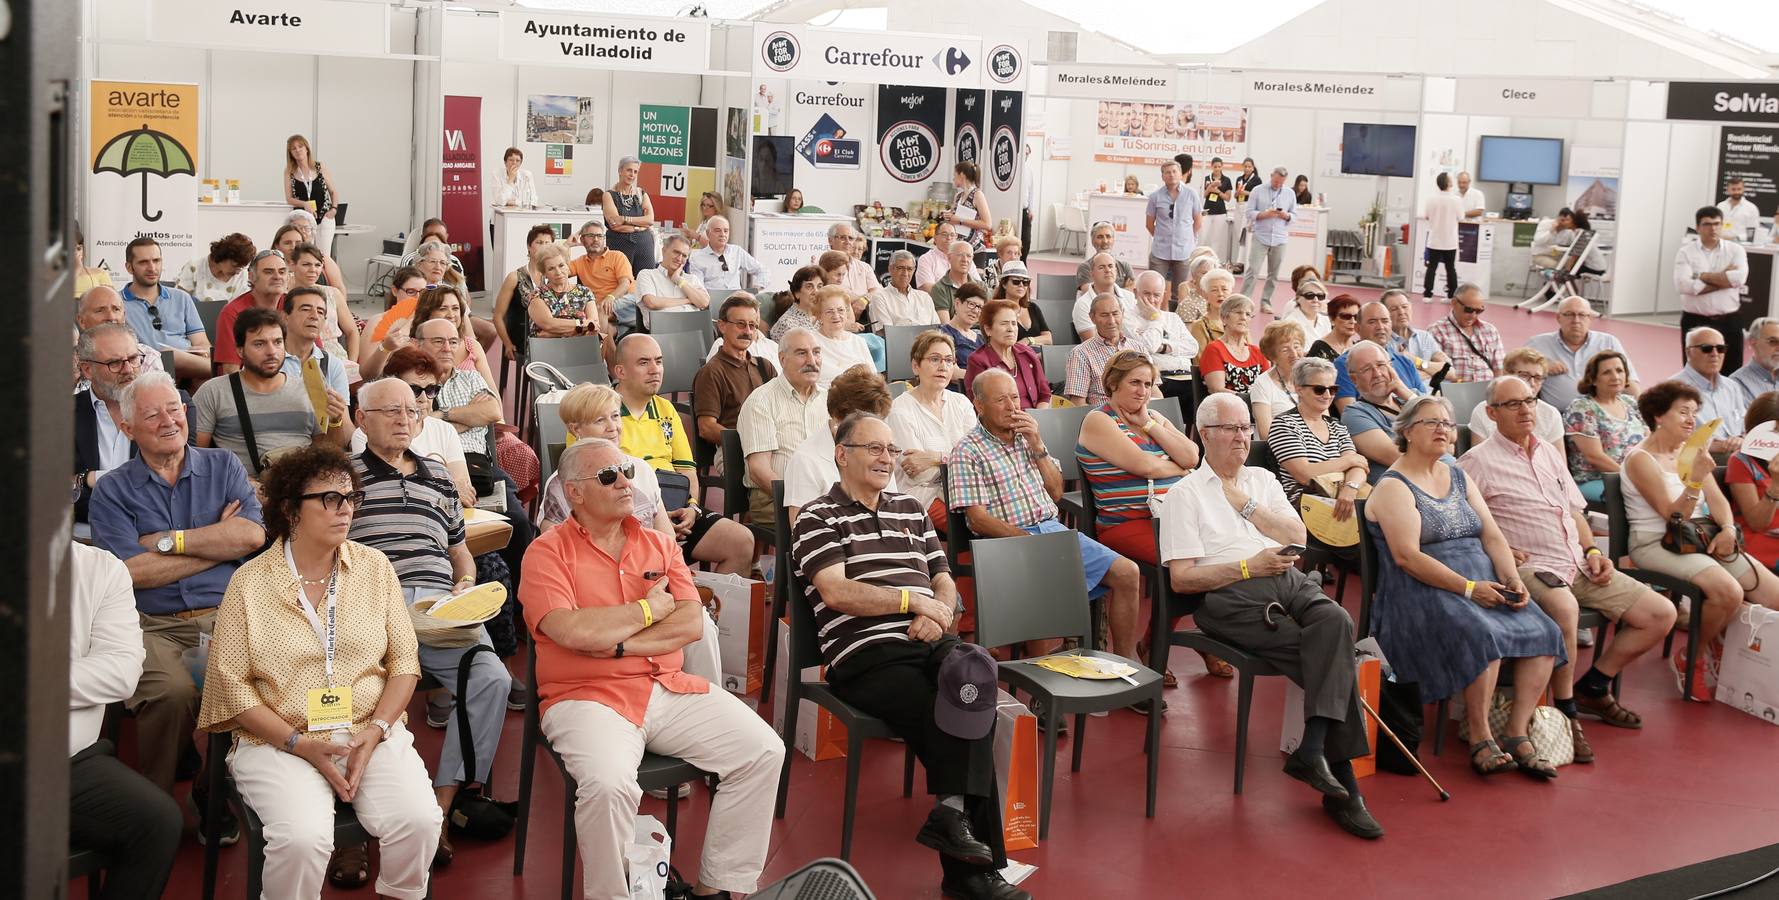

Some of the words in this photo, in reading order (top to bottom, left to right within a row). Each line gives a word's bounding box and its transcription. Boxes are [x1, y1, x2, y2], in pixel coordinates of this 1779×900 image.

[230, 9, 301, 27] Avarte
[524, 20, 657, 41] Ayuntamiento
[663, 28, 686, 43] de
[560, 41, 652, 60] Valladolid
[774, 53, 792, 63] FOOD
[824, 45, 923, 69] Carrefour
[1058, 73, 1167, 86] Morales&Meléndez
[1253, 80, 1375, 95] Morales&Meléndez
[1502, 88, 1536, 99] Clece
[108, 89, 180, 108] avarte
[796, 91, 864, 107] Carrefour
[900, 93, 925, 109] mejor
[1713, 91, 1779, 113] Solvia
[643, 111, 657, 120] UN
[642, 123, 682, 135] MOTIVO,
[642, 134, 666, 144] MILES
[669, 136, 682, 145] DE
[796, 132, 815, 152] PASS
[1121, 138, 1134, 148] Tu
[1134, 139, 1180, 153] Sonrisa,
[1198, 145, 1212, 153] un
[1727, 133, 1773, 144] Residencial
[641, 146, 684, 157] RAZONES
[900, 145, 921, 159] FOR
[1726, 142, 1752, 152] Tercer
[899, 155, 927, 170] FOOD
[998, 162, 1011, 177] FOOD
[662, 171, 685, 191] TÚ
[134, 231, 170, 239] Juntos
[96, 239, 128, 247] Atención
[778, 256, 798, 265] AQUÍ
[328, 606, 336, 629] Castilla
